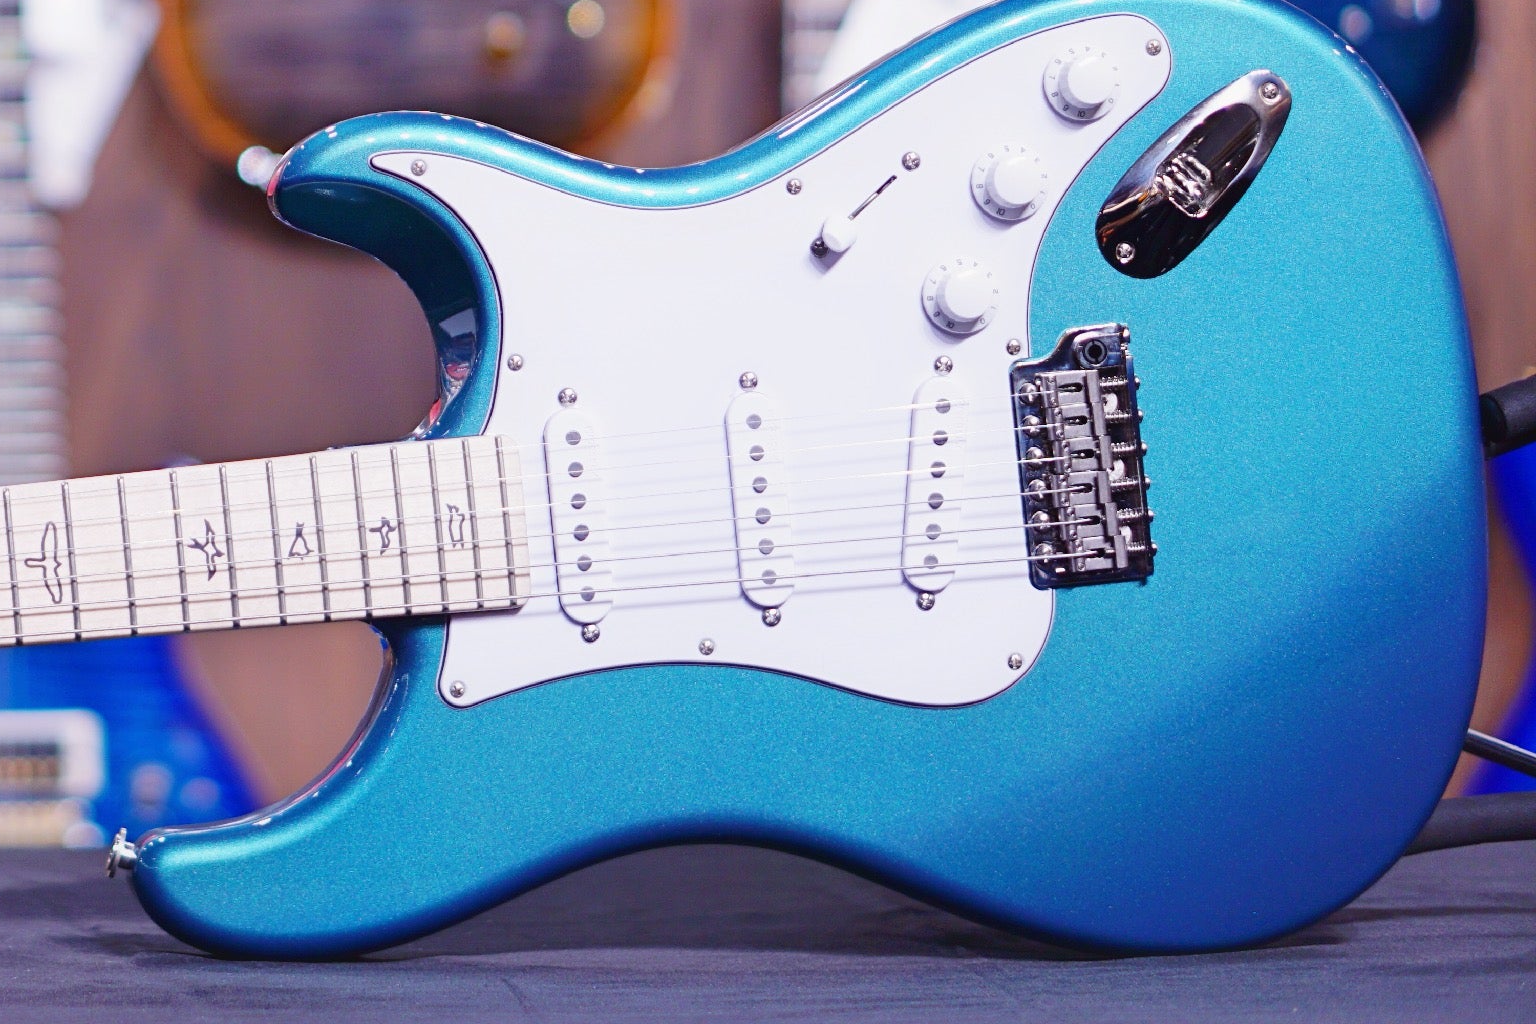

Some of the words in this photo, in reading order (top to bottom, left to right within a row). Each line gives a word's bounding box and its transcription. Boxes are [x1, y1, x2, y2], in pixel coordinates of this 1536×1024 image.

[1077, 110, 1086, 118] 10
[996, 208, 1006, 216] 10
[946, 321, 955, 329] 10
